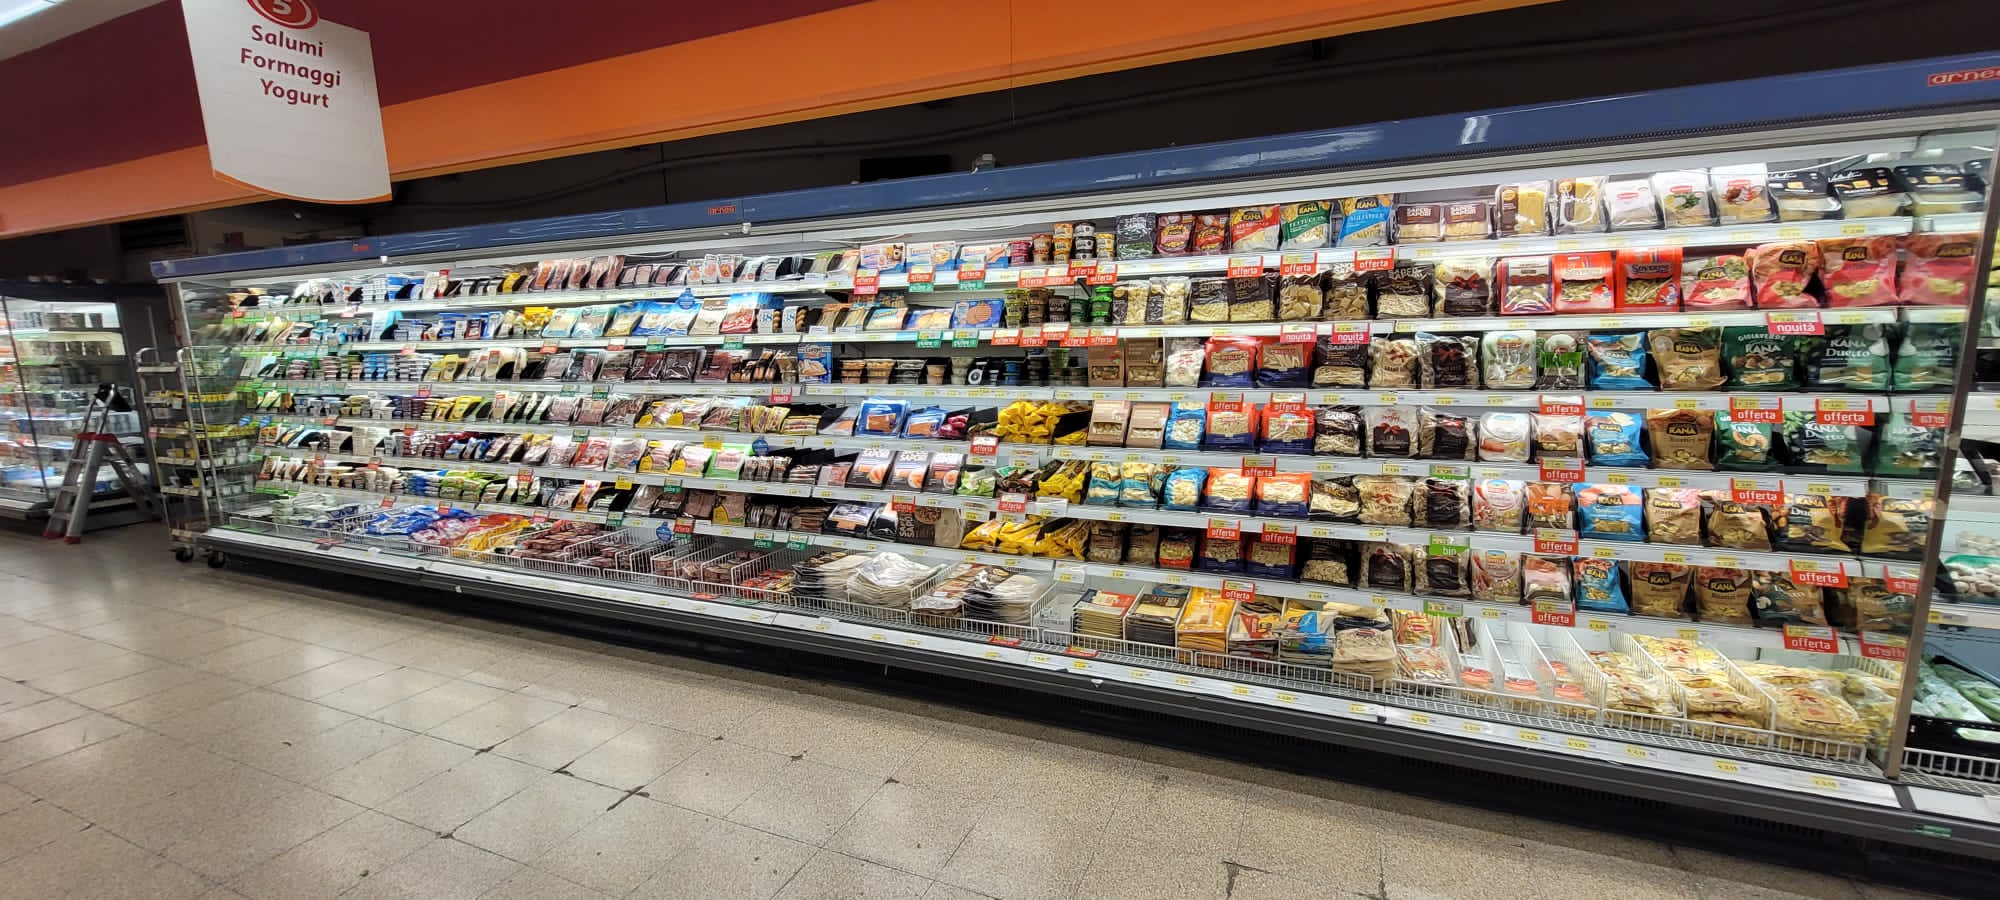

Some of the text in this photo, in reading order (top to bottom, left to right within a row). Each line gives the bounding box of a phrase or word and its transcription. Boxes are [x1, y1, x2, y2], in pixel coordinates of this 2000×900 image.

[251, 25, 324, 57] Salumi
[241, 47, 341, 88] Formaggi
[260, 78, 329, 108] Yogurt
[1360, 259, 1389, 268] offerta
[1285, 264, 1312, 273] offerta
[1090, 274, 1113, 282] offerta
[1777, 322, 1816, 332] novità
[1337, 332, 1364, 341] novità
[1214, 402, 1239, 410] offerta
[1546, 404, 1580, 413] offerta
[1738, 410, 1776, 420] offerta
[1823, 411, 1865, 422] offerta
[1669, 425, 1698, 435] RANA
[1245, 467, 1273, 476] offerta
[1546, 470, 1579, 479] offerta
[1739, 491, 1777, 501] offerta
[1211, 528, 1236, 537] offerta
[1265, 534, 1294, 543] offerta
[1540, 541, 1573, 551] offerta
[1799, 573, 1840, 584] offerta
[1710, 582, 1736, 591] RANA
[1226, 590, 1250, 599] offerta
[1538, 613, 1570, 623] offerta
[1791, 637, 1832, 650] offerta
